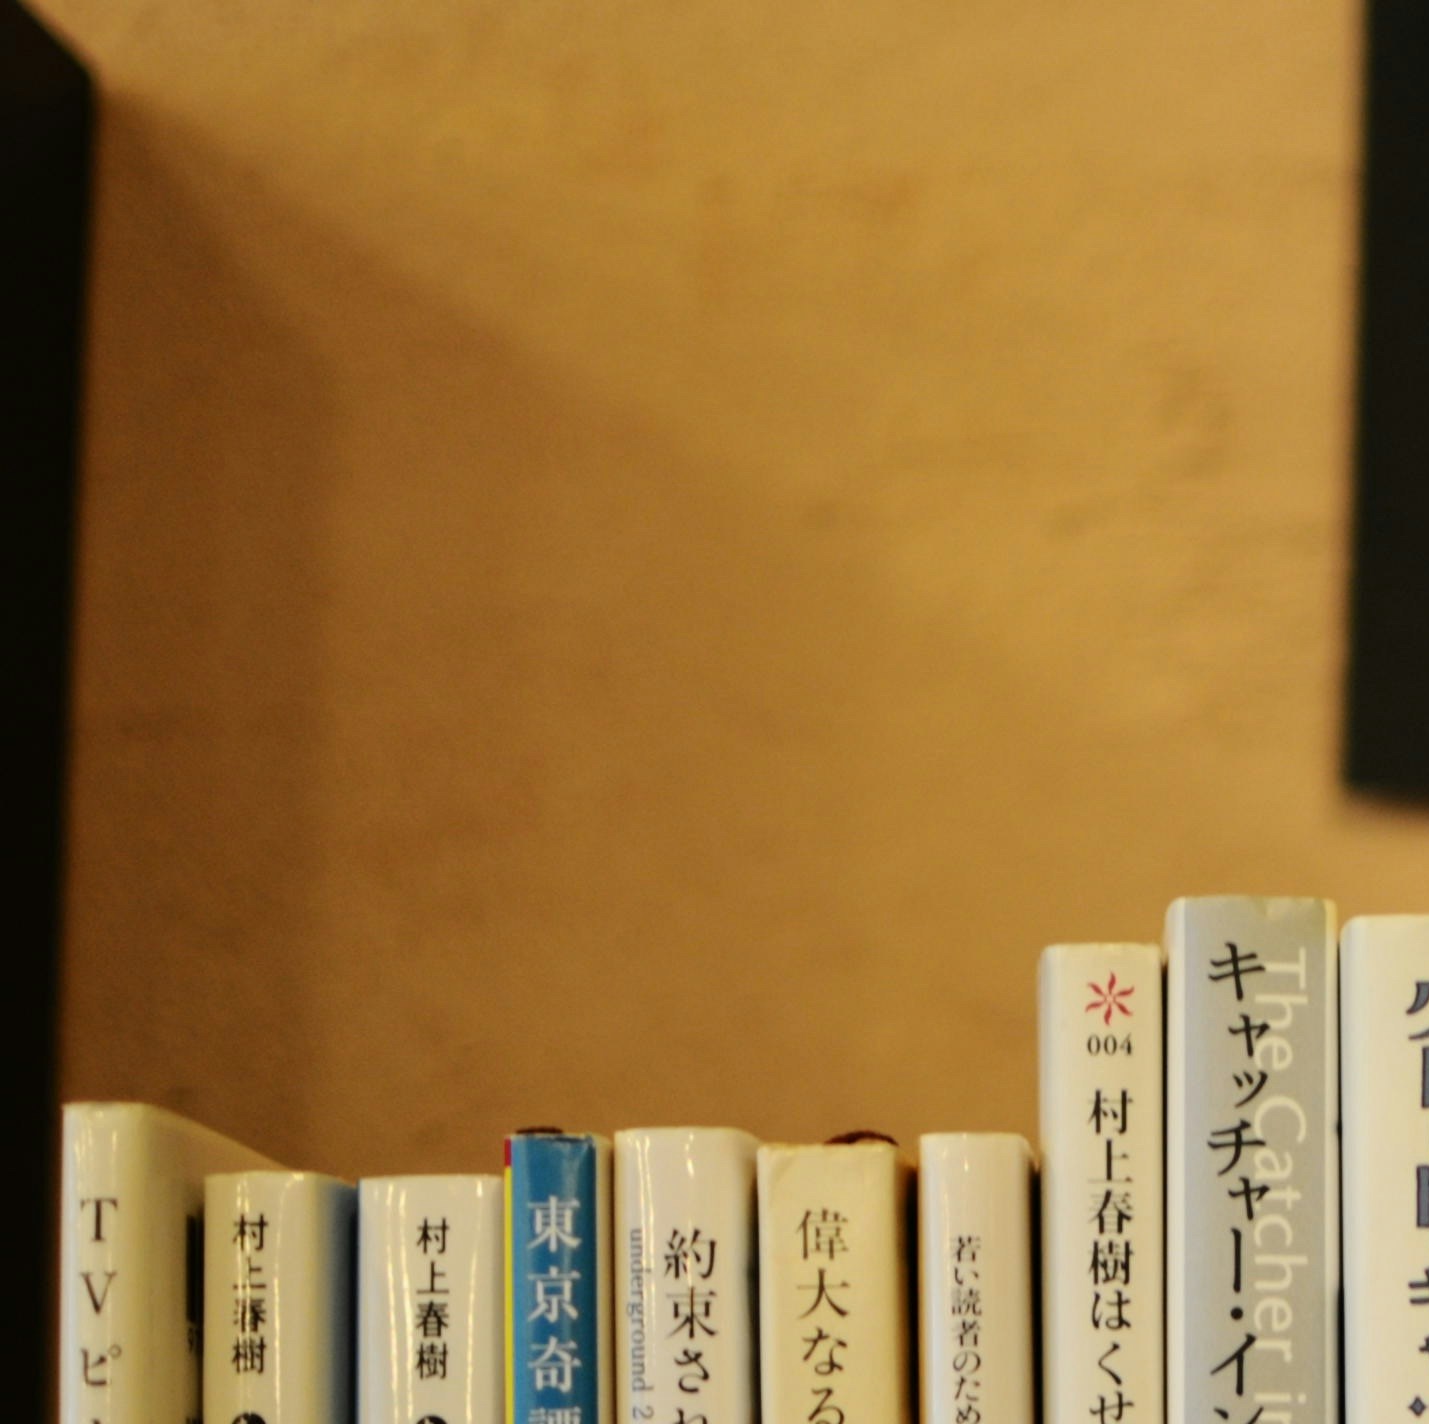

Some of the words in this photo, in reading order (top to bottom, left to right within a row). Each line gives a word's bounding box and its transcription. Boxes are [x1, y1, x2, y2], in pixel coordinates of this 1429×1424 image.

[1086, 1035, 1134, 1056] 004
[1253, 946, 1309, 1071] The
[232, 1213, 268, 1375] 村上春樹
[415, 1217, 450, 1380] 村上春樹
[1253, 1094, 1309, 1362] Catcher
